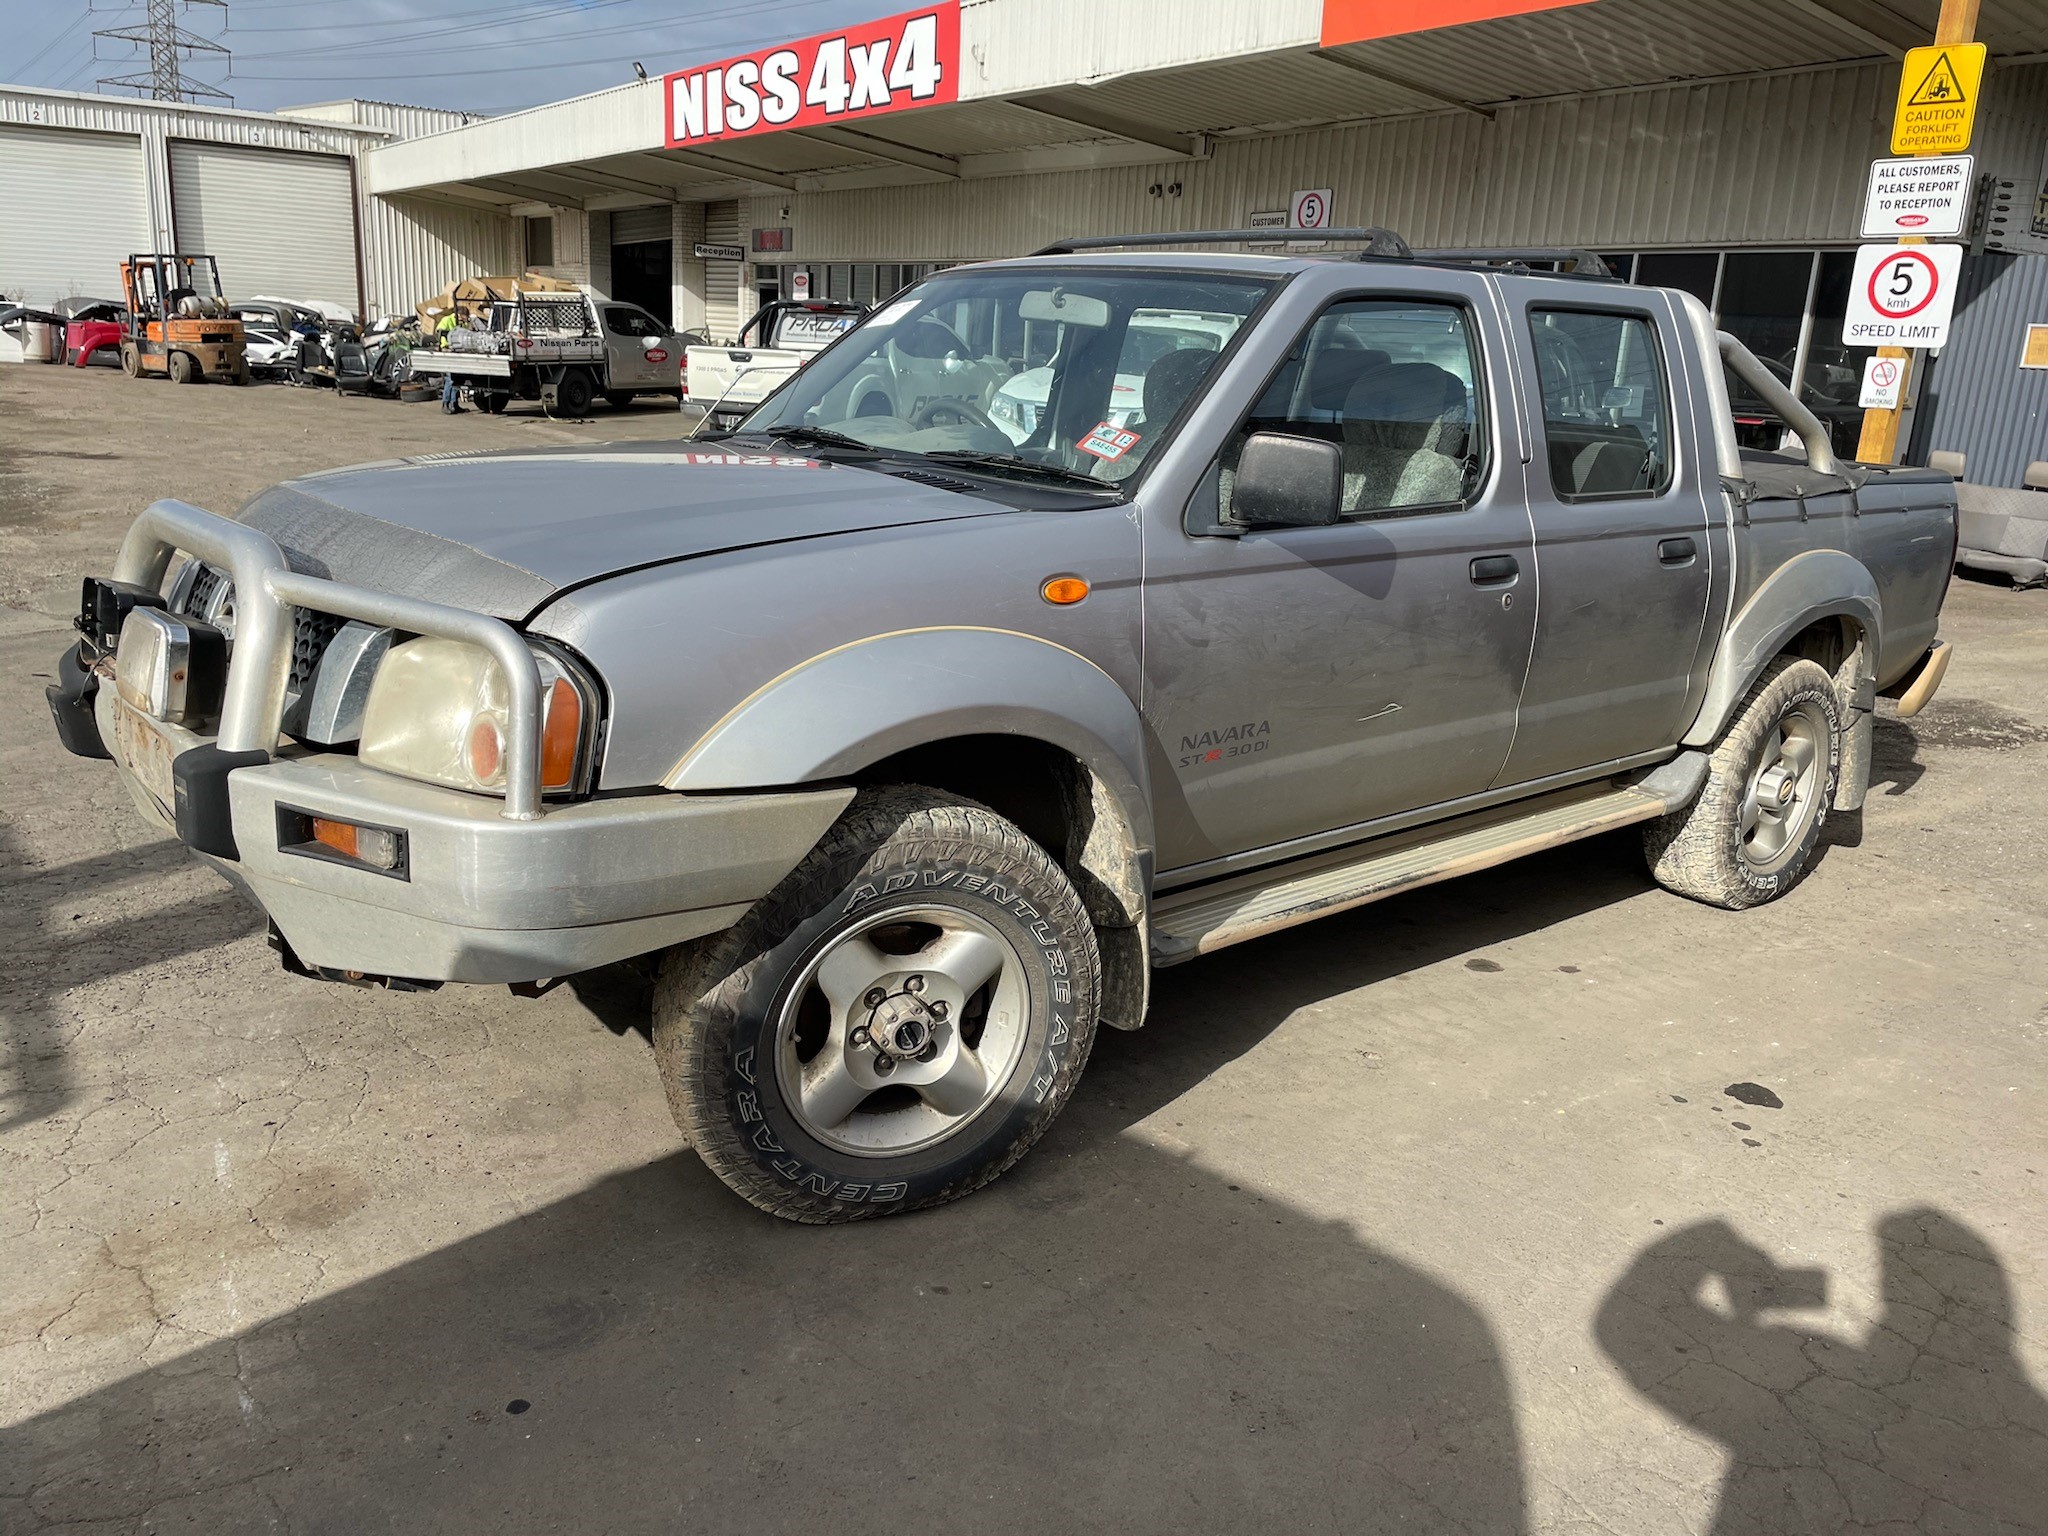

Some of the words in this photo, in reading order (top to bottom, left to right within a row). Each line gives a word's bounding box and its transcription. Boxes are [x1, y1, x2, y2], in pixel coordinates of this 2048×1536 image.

[672, 49, 800, 142] NISS
[805, 13, 942, 115] 4x4
[33, 110, 40, 121] 2
[1905, 108, 1965, 122] CAUTION
[1906, 123, 1959, 134] FORKLIFT
[253, 132, 260, 143] 3
[1899, 135, 1961, 146] OPERATING
[1878, 167, 1896, 178] ALL
[1899, 164, 1963, 177] CUSTOMERS,
[1877, 183, 1916, 194] PLEASE
[1918, 181, 1960, 192] REPORT
[1306, 199, 1315, 218] 5
[1880, 200, 1892, 209] TO
[1894, 198, 1951, 209] RECEPTION
[1252, 217, 1285, 226] CUSTOMER
[696, 246, 741, 257] Reception
[1889, 262, 1914, 296] 5
[1886, 298, 1910, 308] kmh
[1851, 324, 1895, 337] SPEED
[1899, 325, 1940, 339] LIMIT
[540, 339, 572, 347] Nissan
[574, 339, 600, 347] Parts
[1875, 388, 1887, 397] NO
[1864, 398, 1893, 406] SMOKING
[1777, 690, 1840, 766] ADVENTURE
[1180, 720, 1271, 752] NAVARA
[842, 869, 1071, 1006] ADVENTURE
[1031, 1011, 1071, 1105] A/T
[733, 1046, 909, 1204] CENTARA
